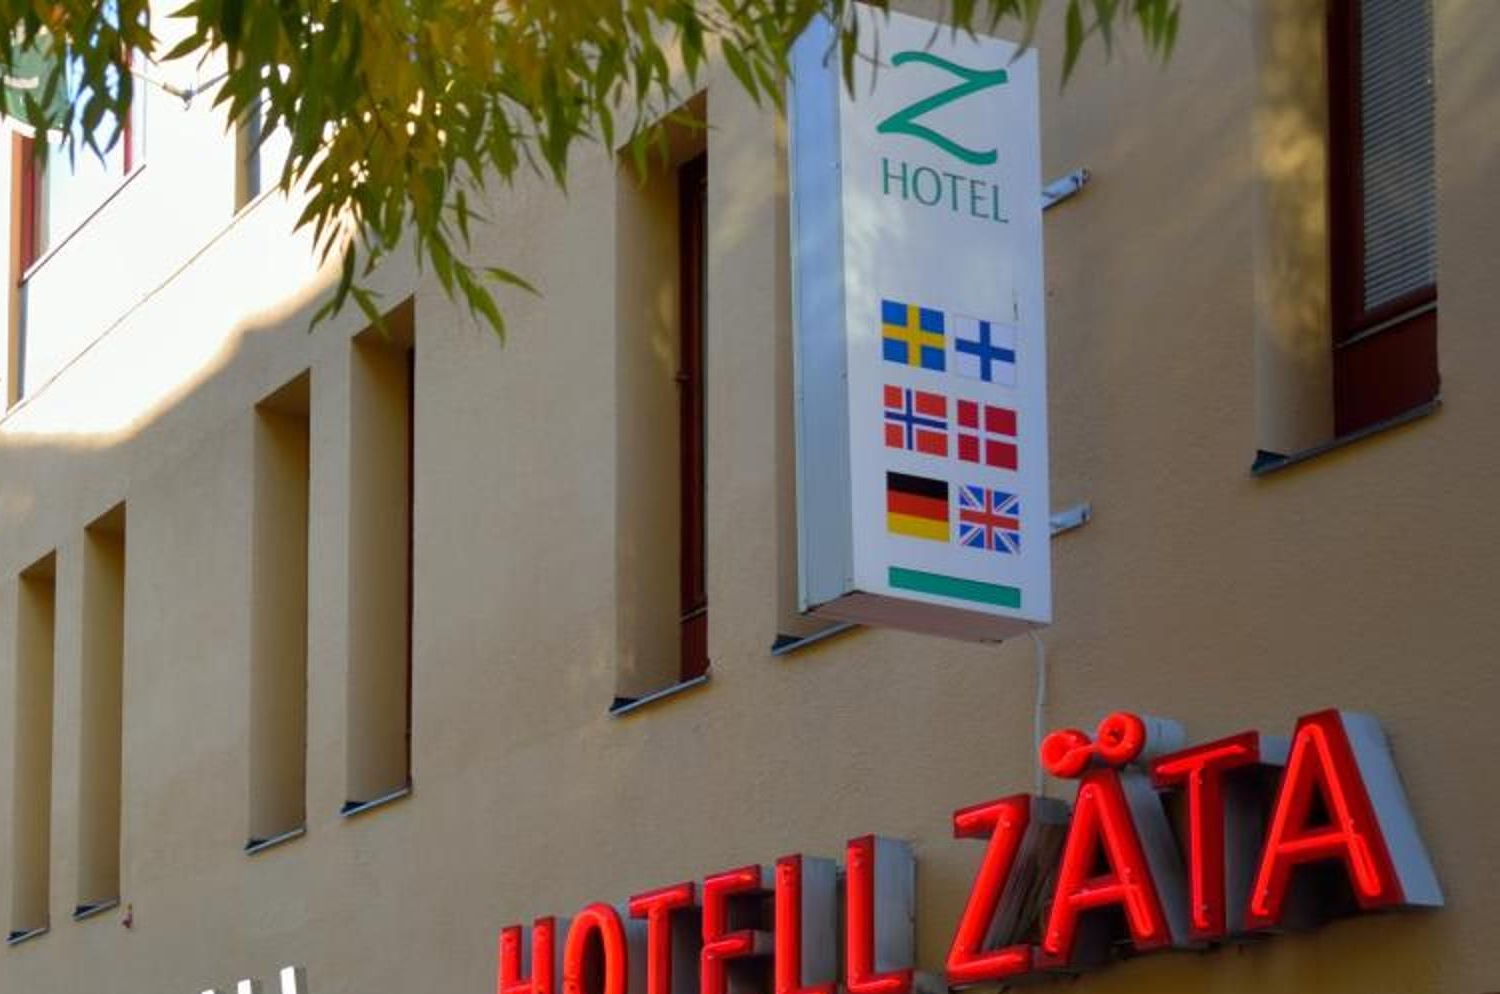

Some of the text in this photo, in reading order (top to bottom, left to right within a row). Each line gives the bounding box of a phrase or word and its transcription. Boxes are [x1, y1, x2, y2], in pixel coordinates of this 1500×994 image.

[876, 50, 1009, 166] Z
[882, 158, 1010, 224] HOTEL
[945, 708, 1406, 986] ZÄTA
